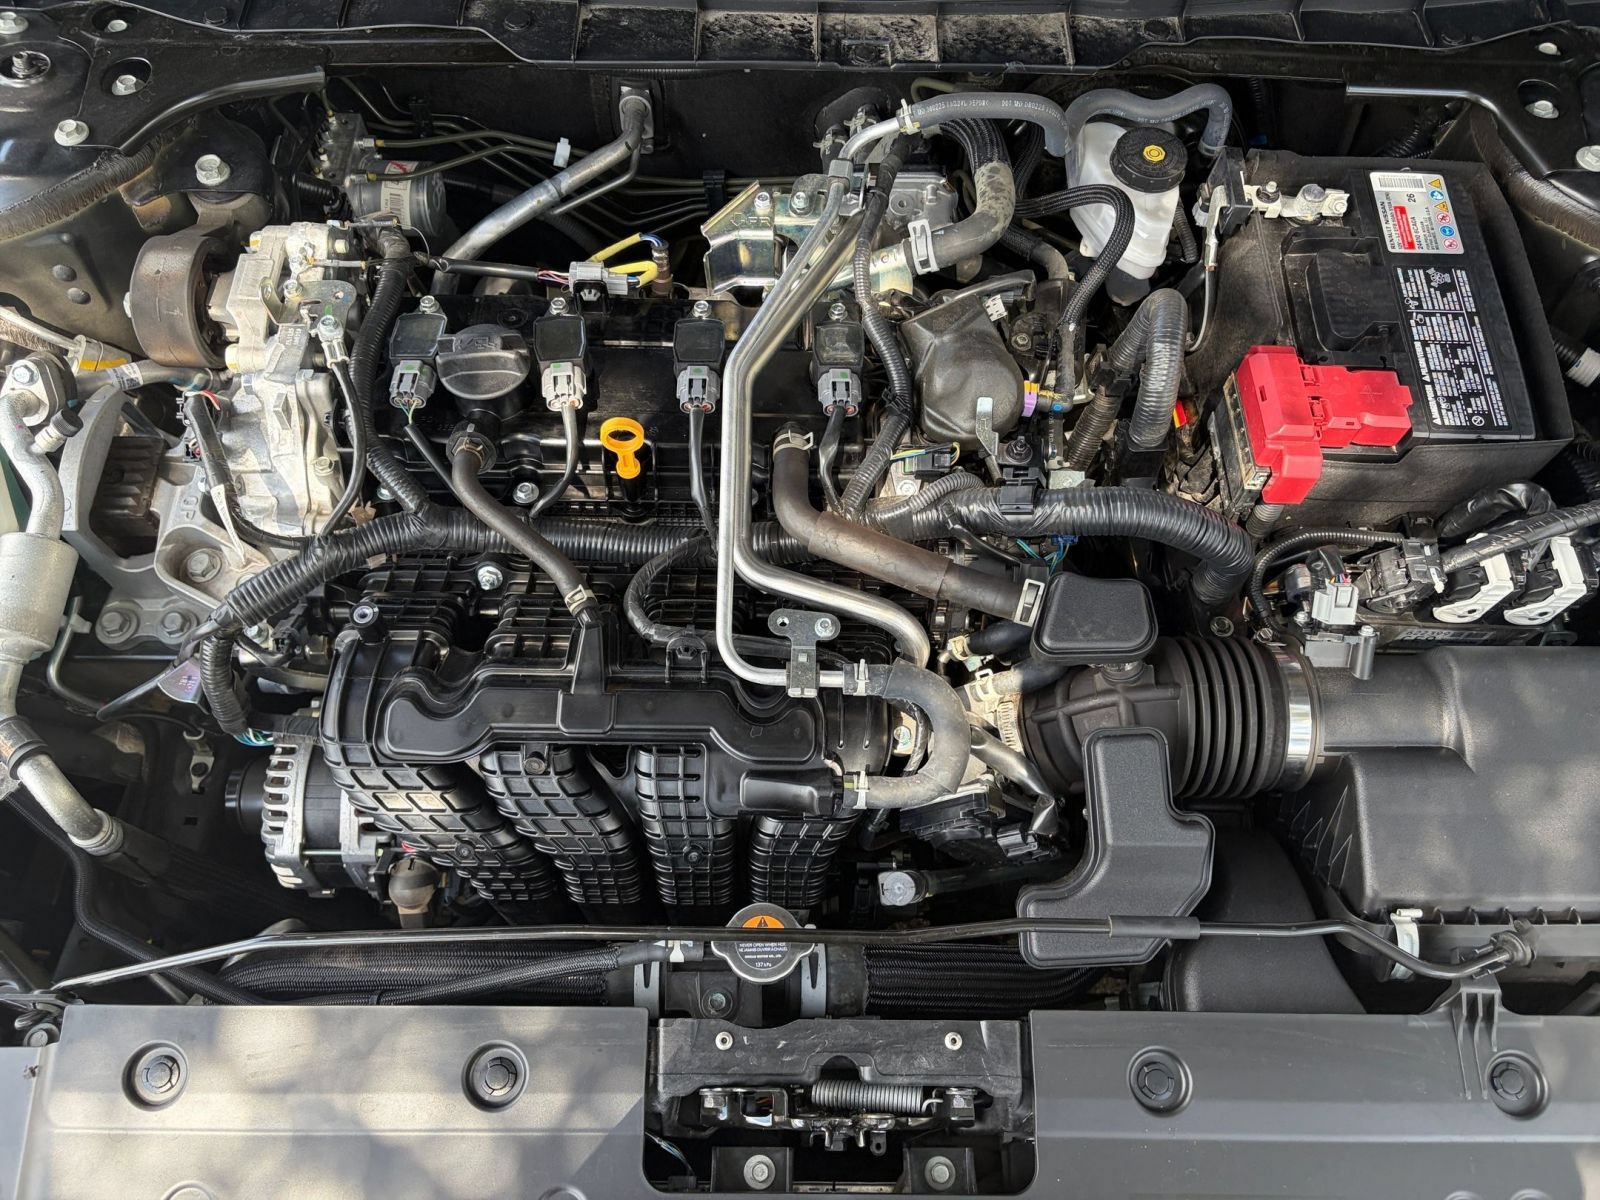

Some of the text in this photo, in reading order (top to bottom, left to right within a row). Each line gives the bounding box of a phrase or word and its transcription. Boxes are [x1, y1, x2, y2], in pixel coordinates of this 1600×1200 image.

[1406, 193, 1416, 202] 26
[1379, 201, 1396, 249] RENAULT NISSAN
